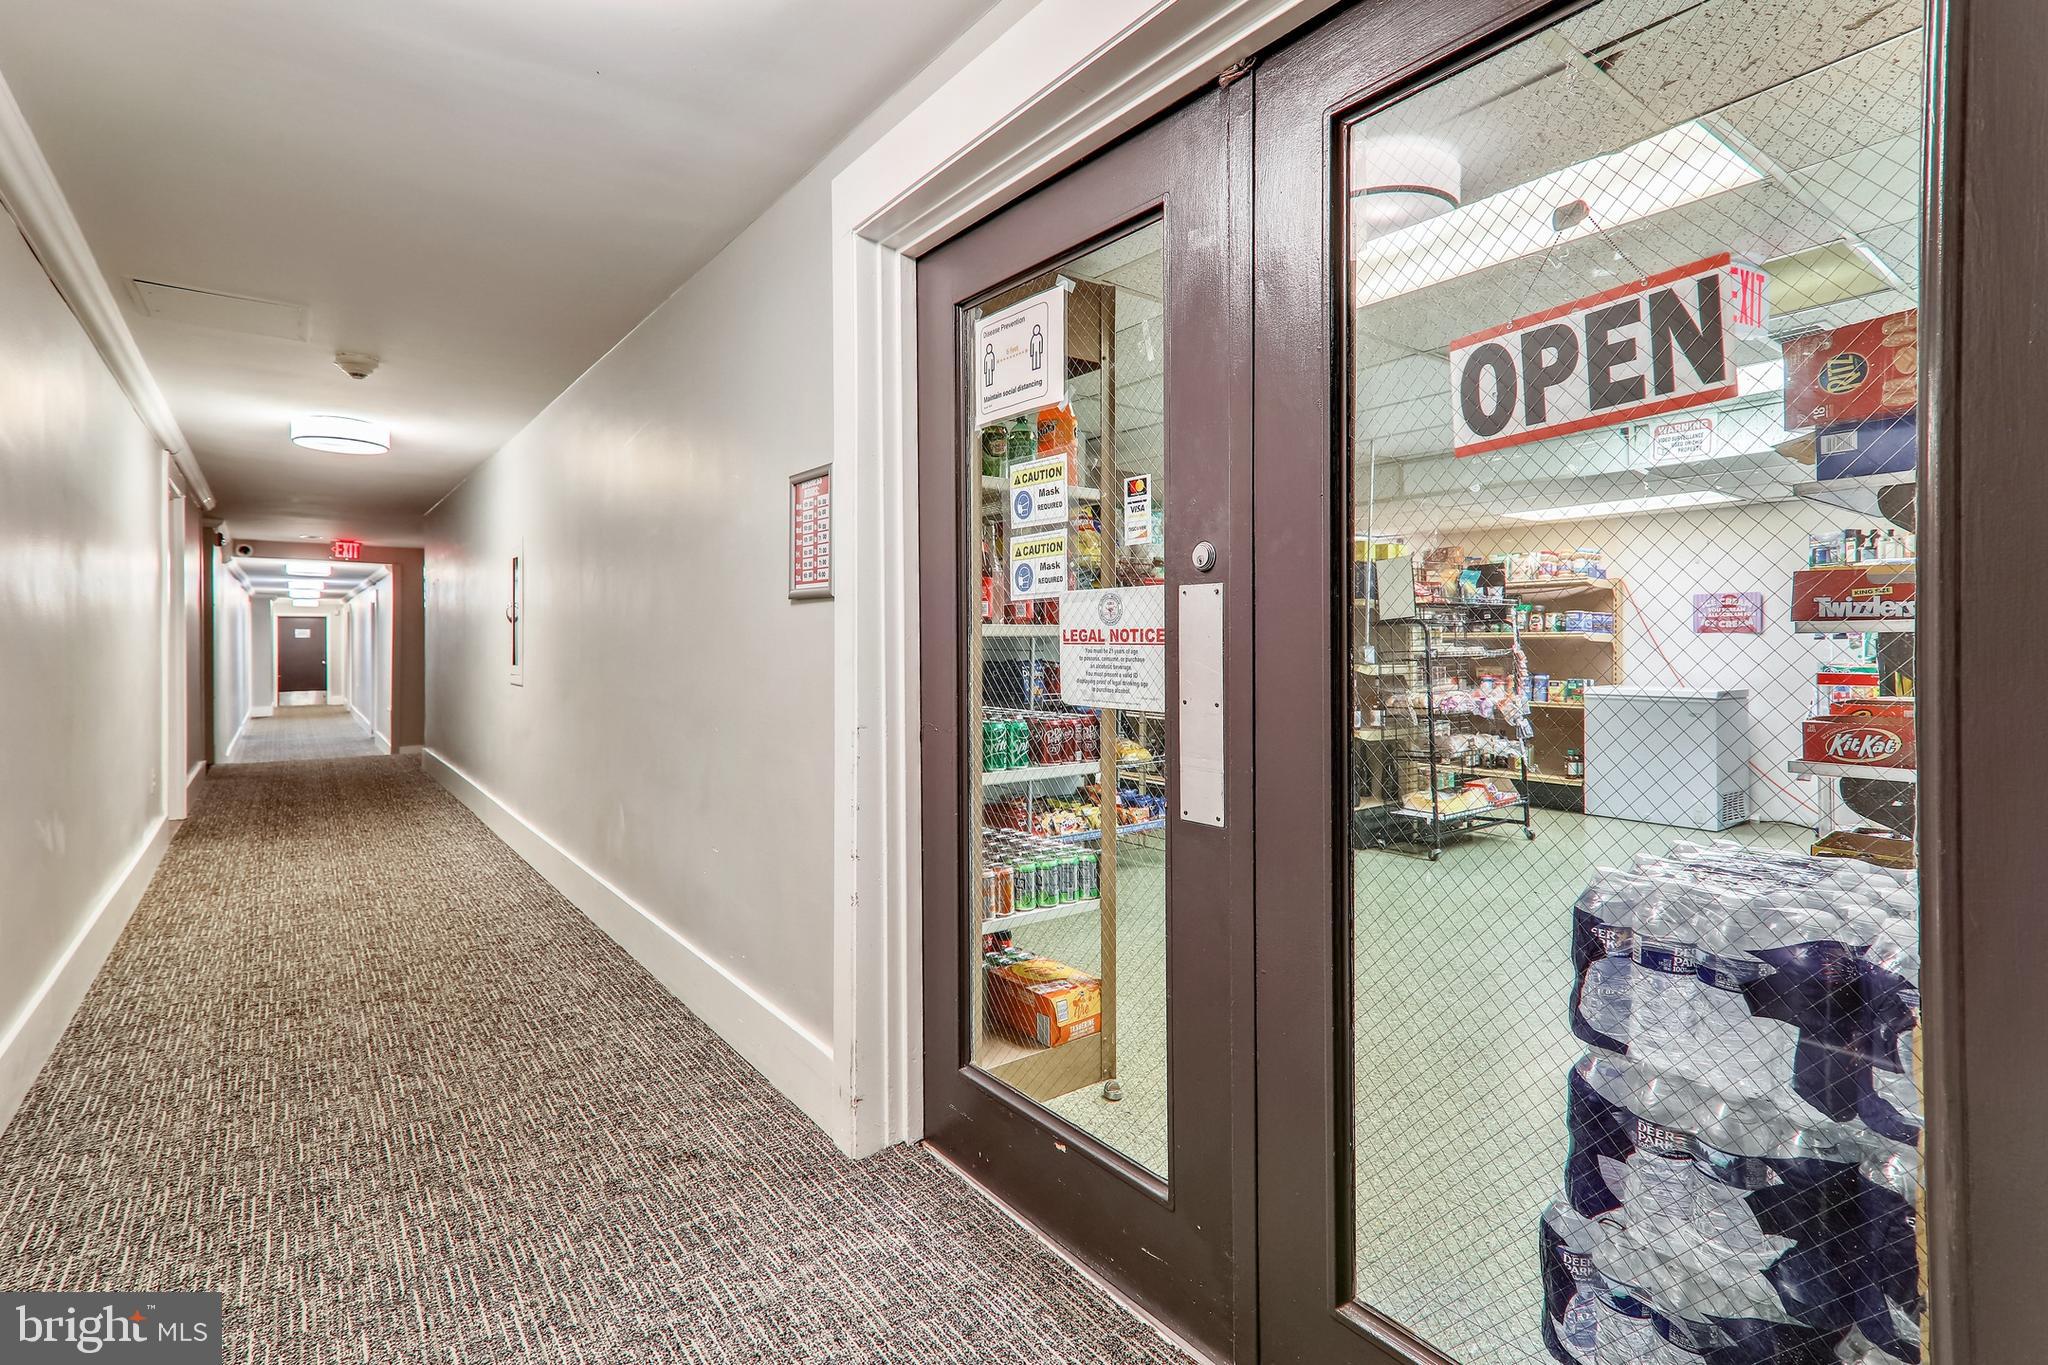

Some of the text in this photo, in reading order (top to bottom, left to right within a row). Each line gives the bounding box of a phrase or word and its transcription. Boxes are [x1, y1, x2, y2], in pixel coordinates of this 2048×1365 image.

[1731, 267, 1764, 328] EXIT
[1001, 316, 1026, 332] Prevention
[1460, 273, 1726, 437] OPEN
[1827, 354, 1862, 394] RITZ
[984, 379, 1042, 403] Maintain social distancing
[1658, 420, 1709, 435] WARNING
[1022, 466, 1062, 484] CAUTION
[1038, 486, 1060, 498] Mask
[1037, 501, 1062, 511] REQUIRED
[1130, 504, 1145, 514] VISA
[335, 542, 360, 558] EXIT
[1023, 541, 1063, 556] CAUTION
[1040, 561, 1060, 571] Mask
[1038, 575, 1063, 585] REQUIRED
[1814, 596, 1916, 617] Twizzlers
[1063, 628, 1165, 642] LEGAL NOTICE
[1637, 1118, 1674, 1141] DEER
[1638, 1131, 1674, 1151] PARK
